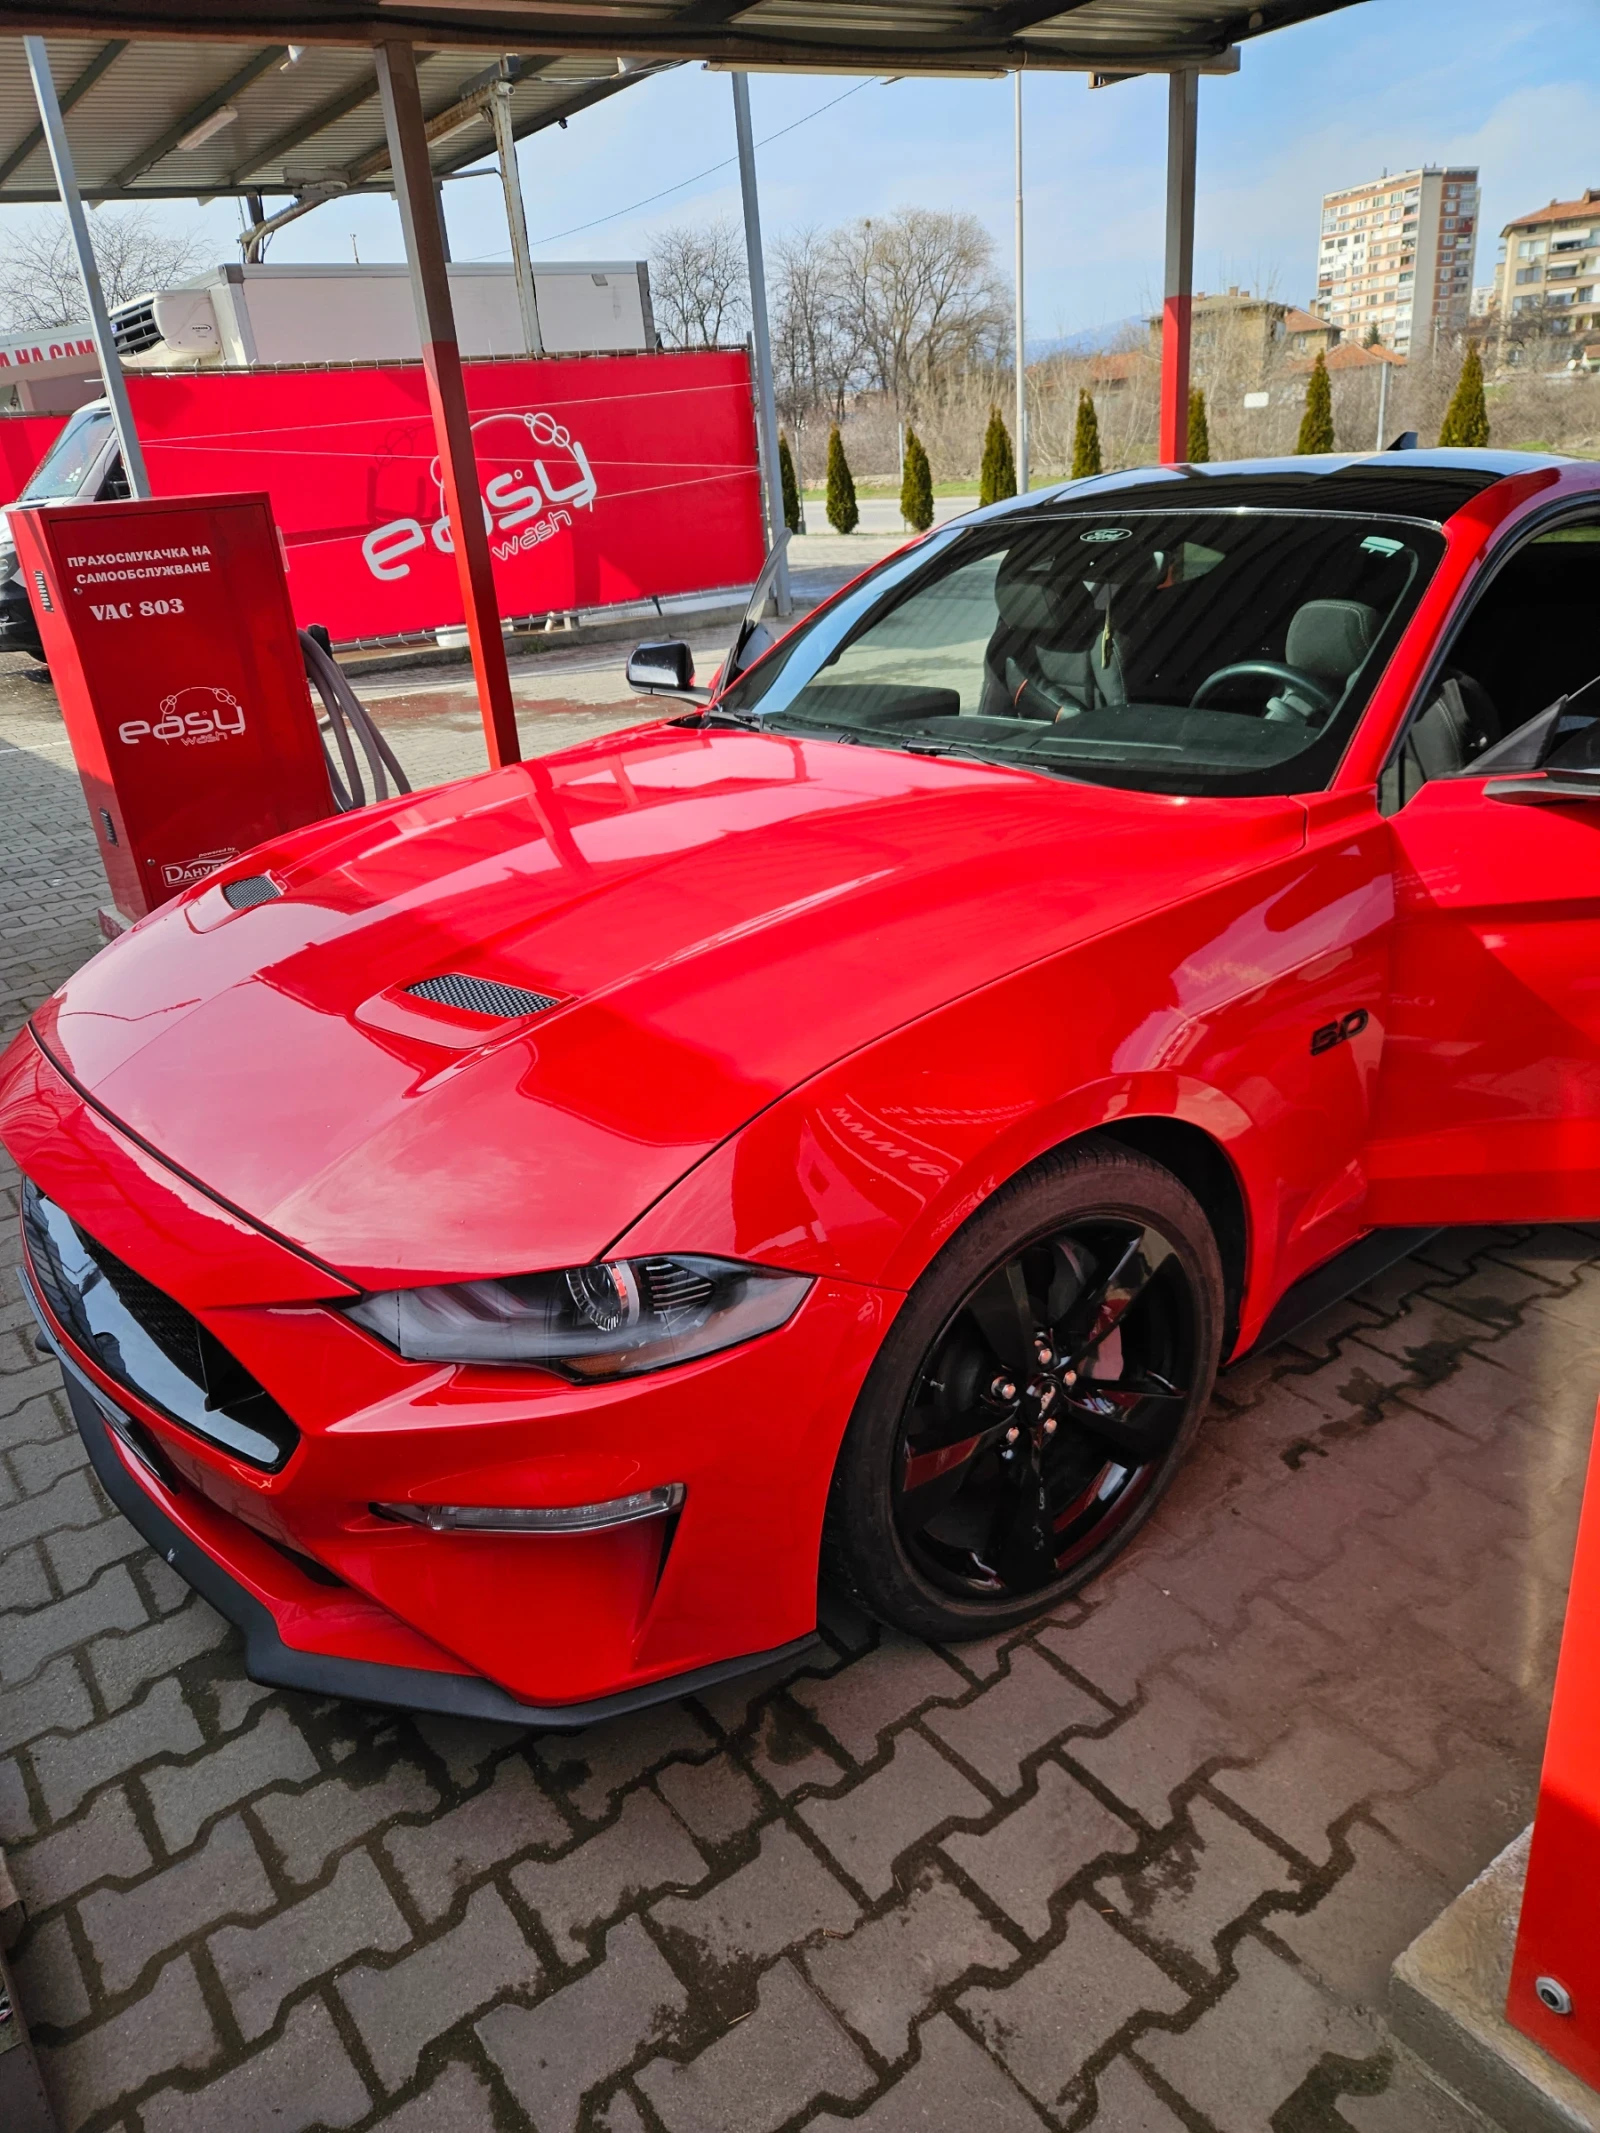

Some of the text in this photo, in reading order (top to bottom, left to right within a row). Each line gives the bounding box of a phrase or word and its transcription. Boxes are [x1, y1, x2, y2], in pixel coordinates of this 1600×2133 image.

[492, 509, 572, 561] wash
[67, 545, 212, 568] ПРАХОСМУКАЧКА НА
[76, 562, 211, 585] САМООБСЛУЖВАНЕ
[89, 598, 185, 621] VAC 803
[118, 705, 246, 744] easy
[180, 731, 228, 746] wash
[198, 847, 227, 859] powered
[1310, 1008, 1369, 1057] 5.0
